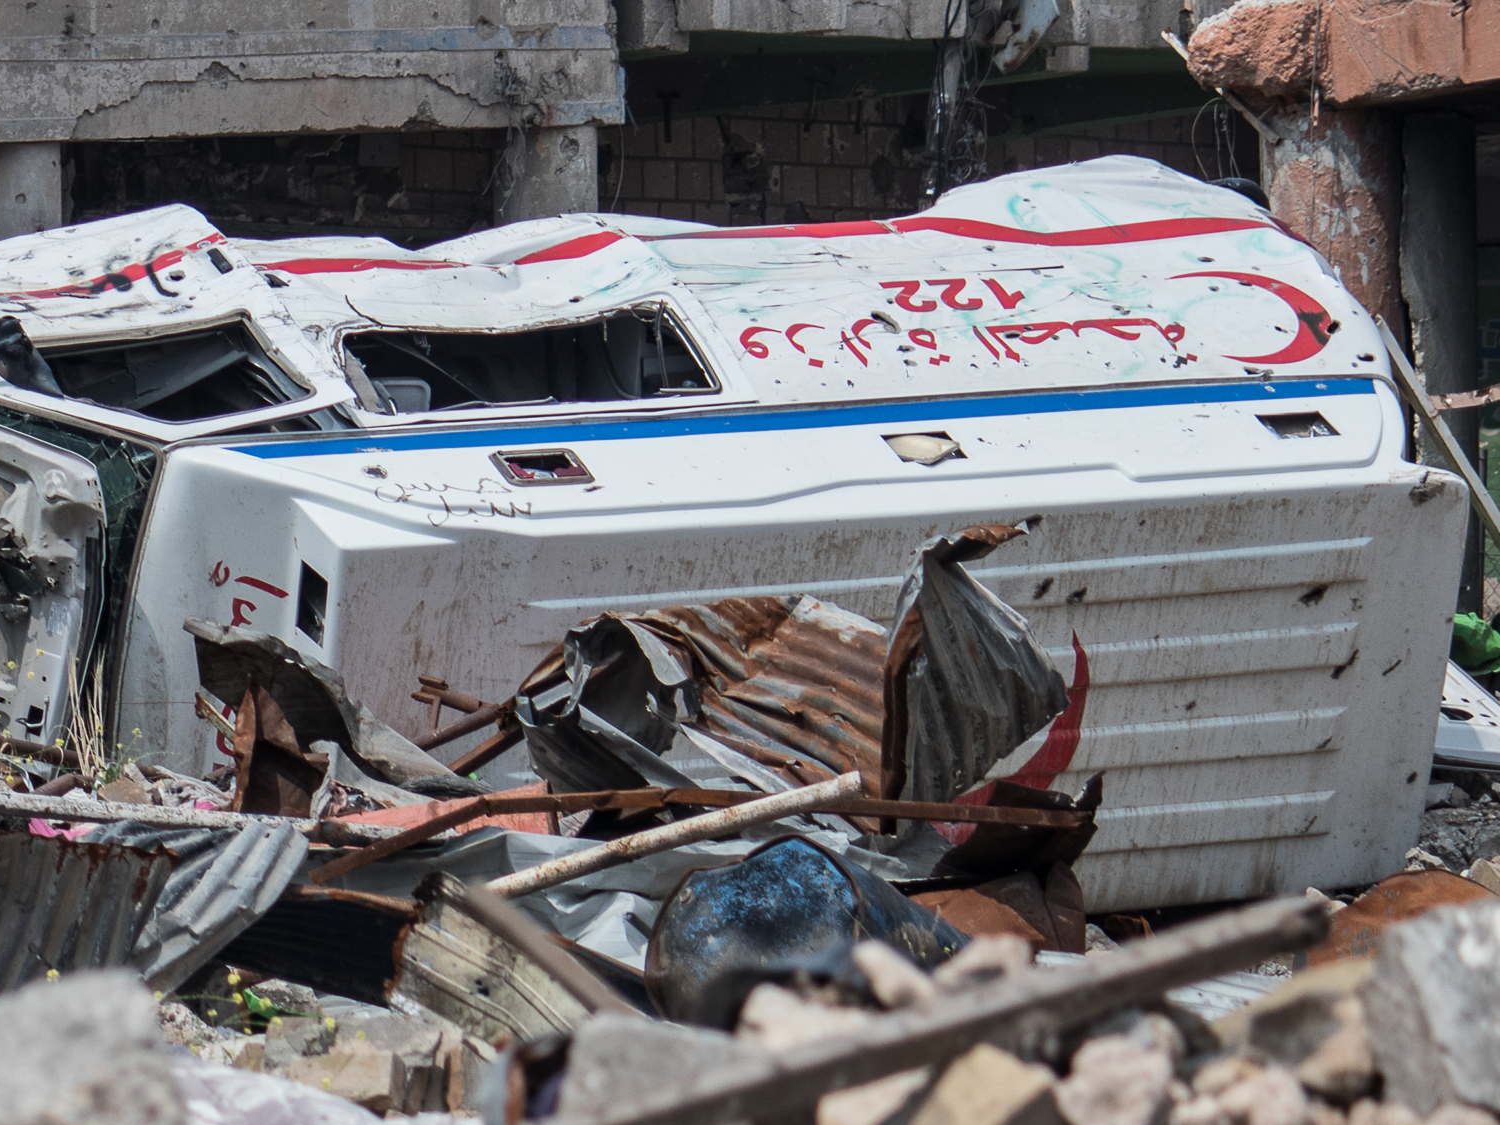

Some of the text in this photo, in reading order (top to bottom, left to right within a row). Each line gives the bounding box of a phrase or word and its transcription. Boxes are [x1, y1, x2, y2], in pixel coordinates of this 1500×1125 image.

[879, 277, 1025, 312] 122
[739, 317, 1198, 368] وزارة الصحة
